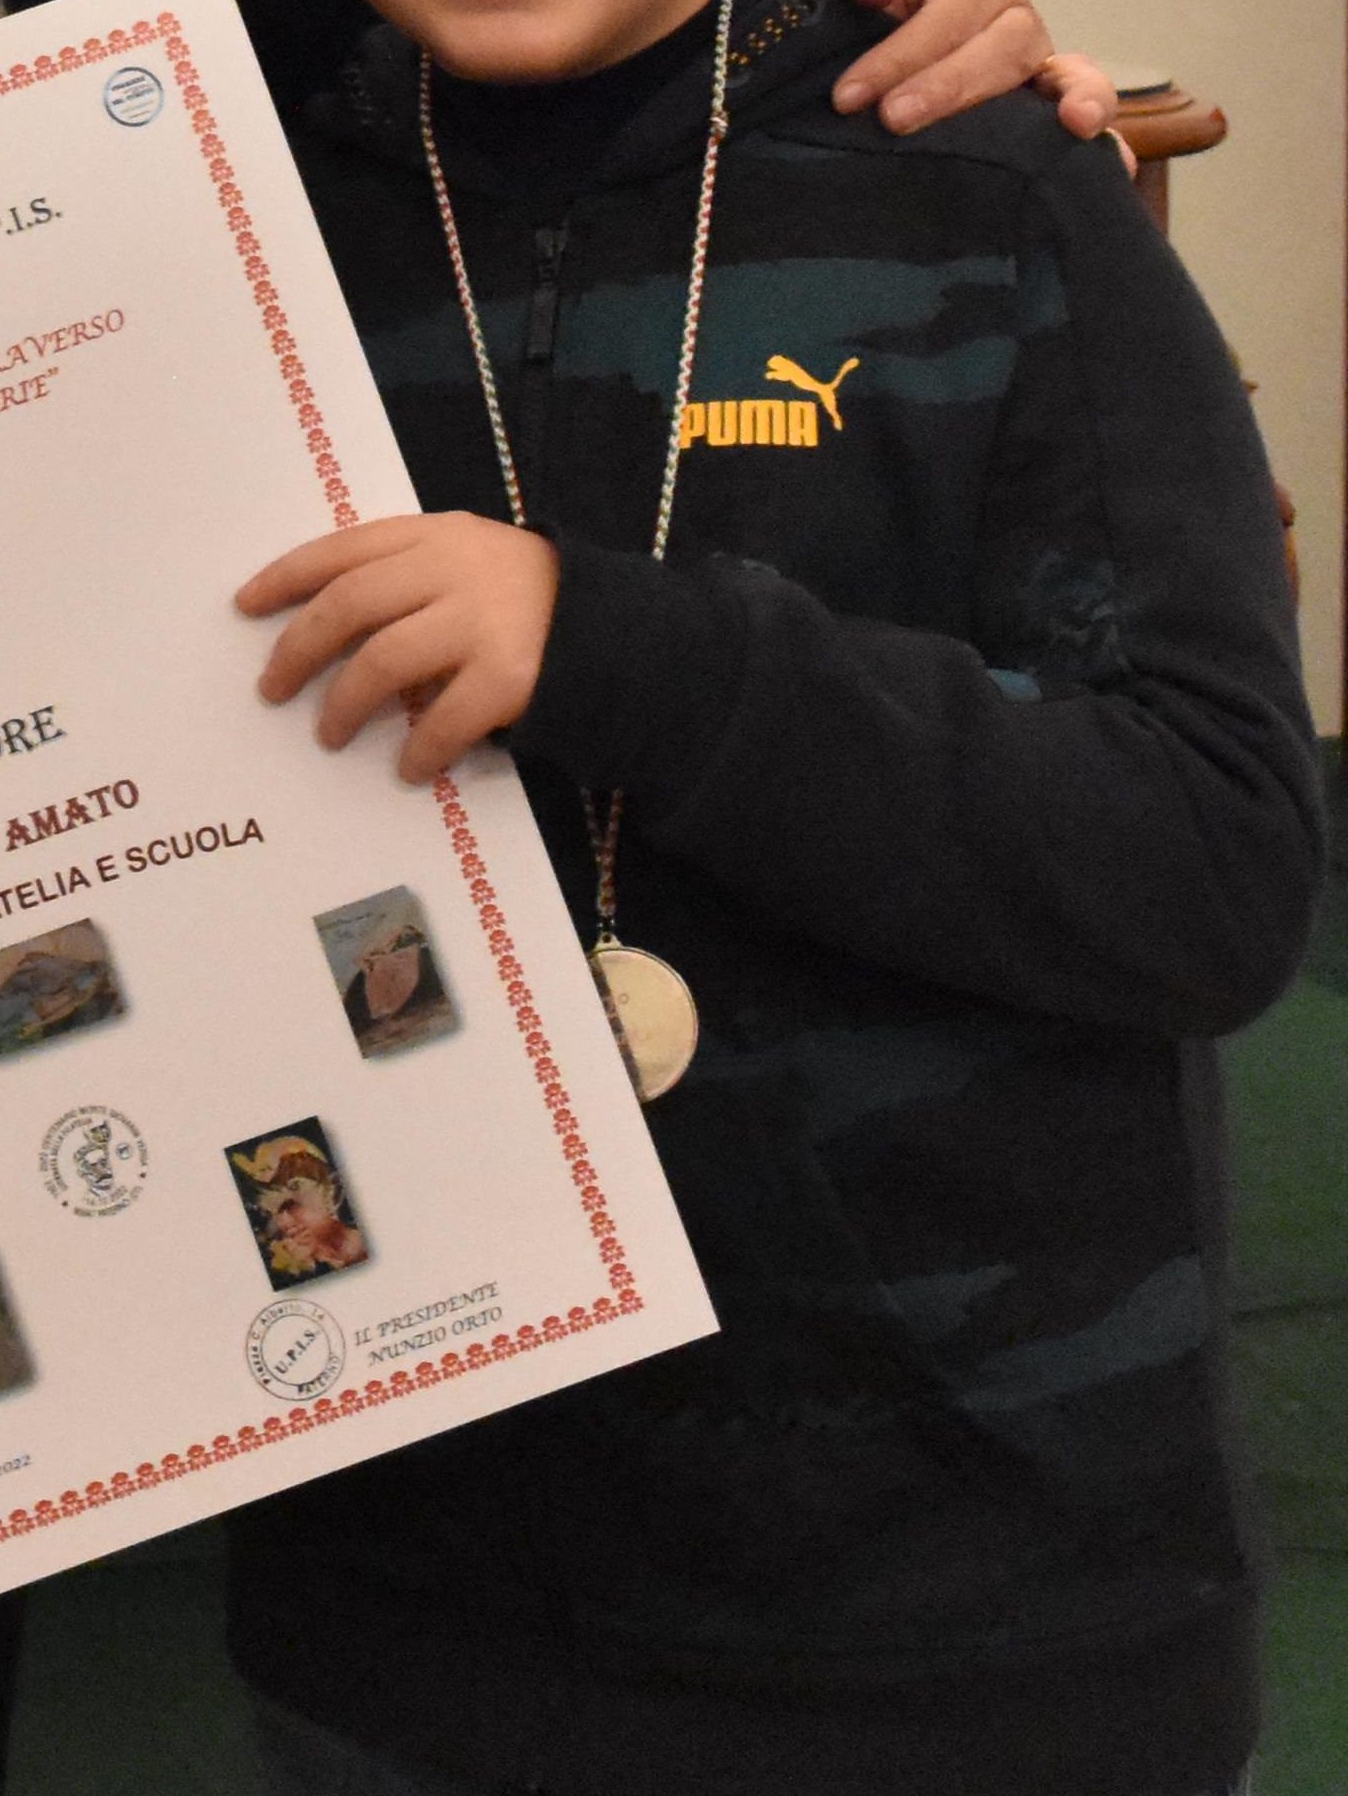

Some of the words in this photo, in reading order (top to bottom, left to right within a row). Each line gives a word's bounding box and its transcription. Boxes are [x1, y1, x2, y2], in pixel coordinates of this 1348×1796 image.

[678, 399, 819, 449] PUMA
[5, 778, 140, 852] AMATO
[96, 855, 120, 882] E
[125, 817, 265, 873] SCUOLA
[354, 1327, 373, 1346] IL
[377, 1281, 500, 1338] PRESIDENTE
[367, 1325, 447, 1366] NUNZIO
[452, 1306, 503, 1336] ORTO
